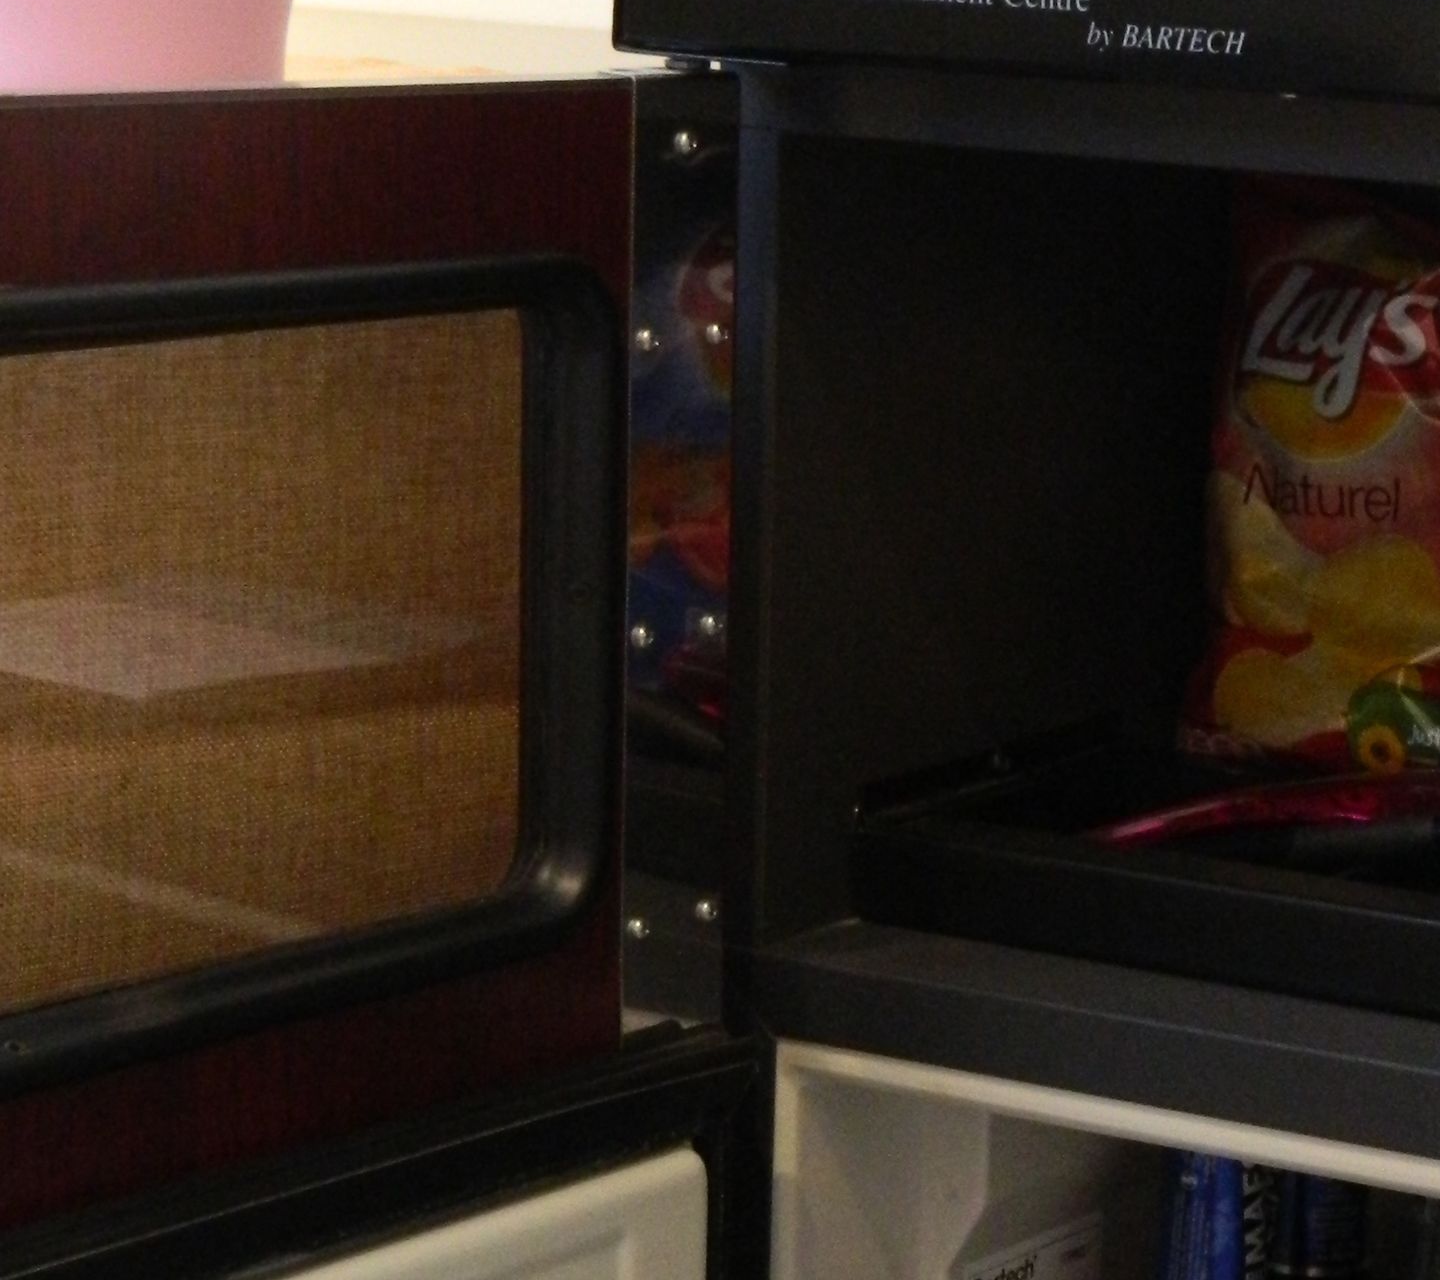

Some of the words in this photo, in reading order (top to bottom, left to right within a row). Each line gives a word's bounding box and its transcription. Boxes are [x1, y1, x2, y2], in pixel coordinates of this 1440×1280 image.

[1087, 21, 1114, 52] by
[1122, 23, 1246, 56] BARTECH
[1240, 263, 1440, 420] Lay's
[1243, 461, 1402, 522] Naturel
